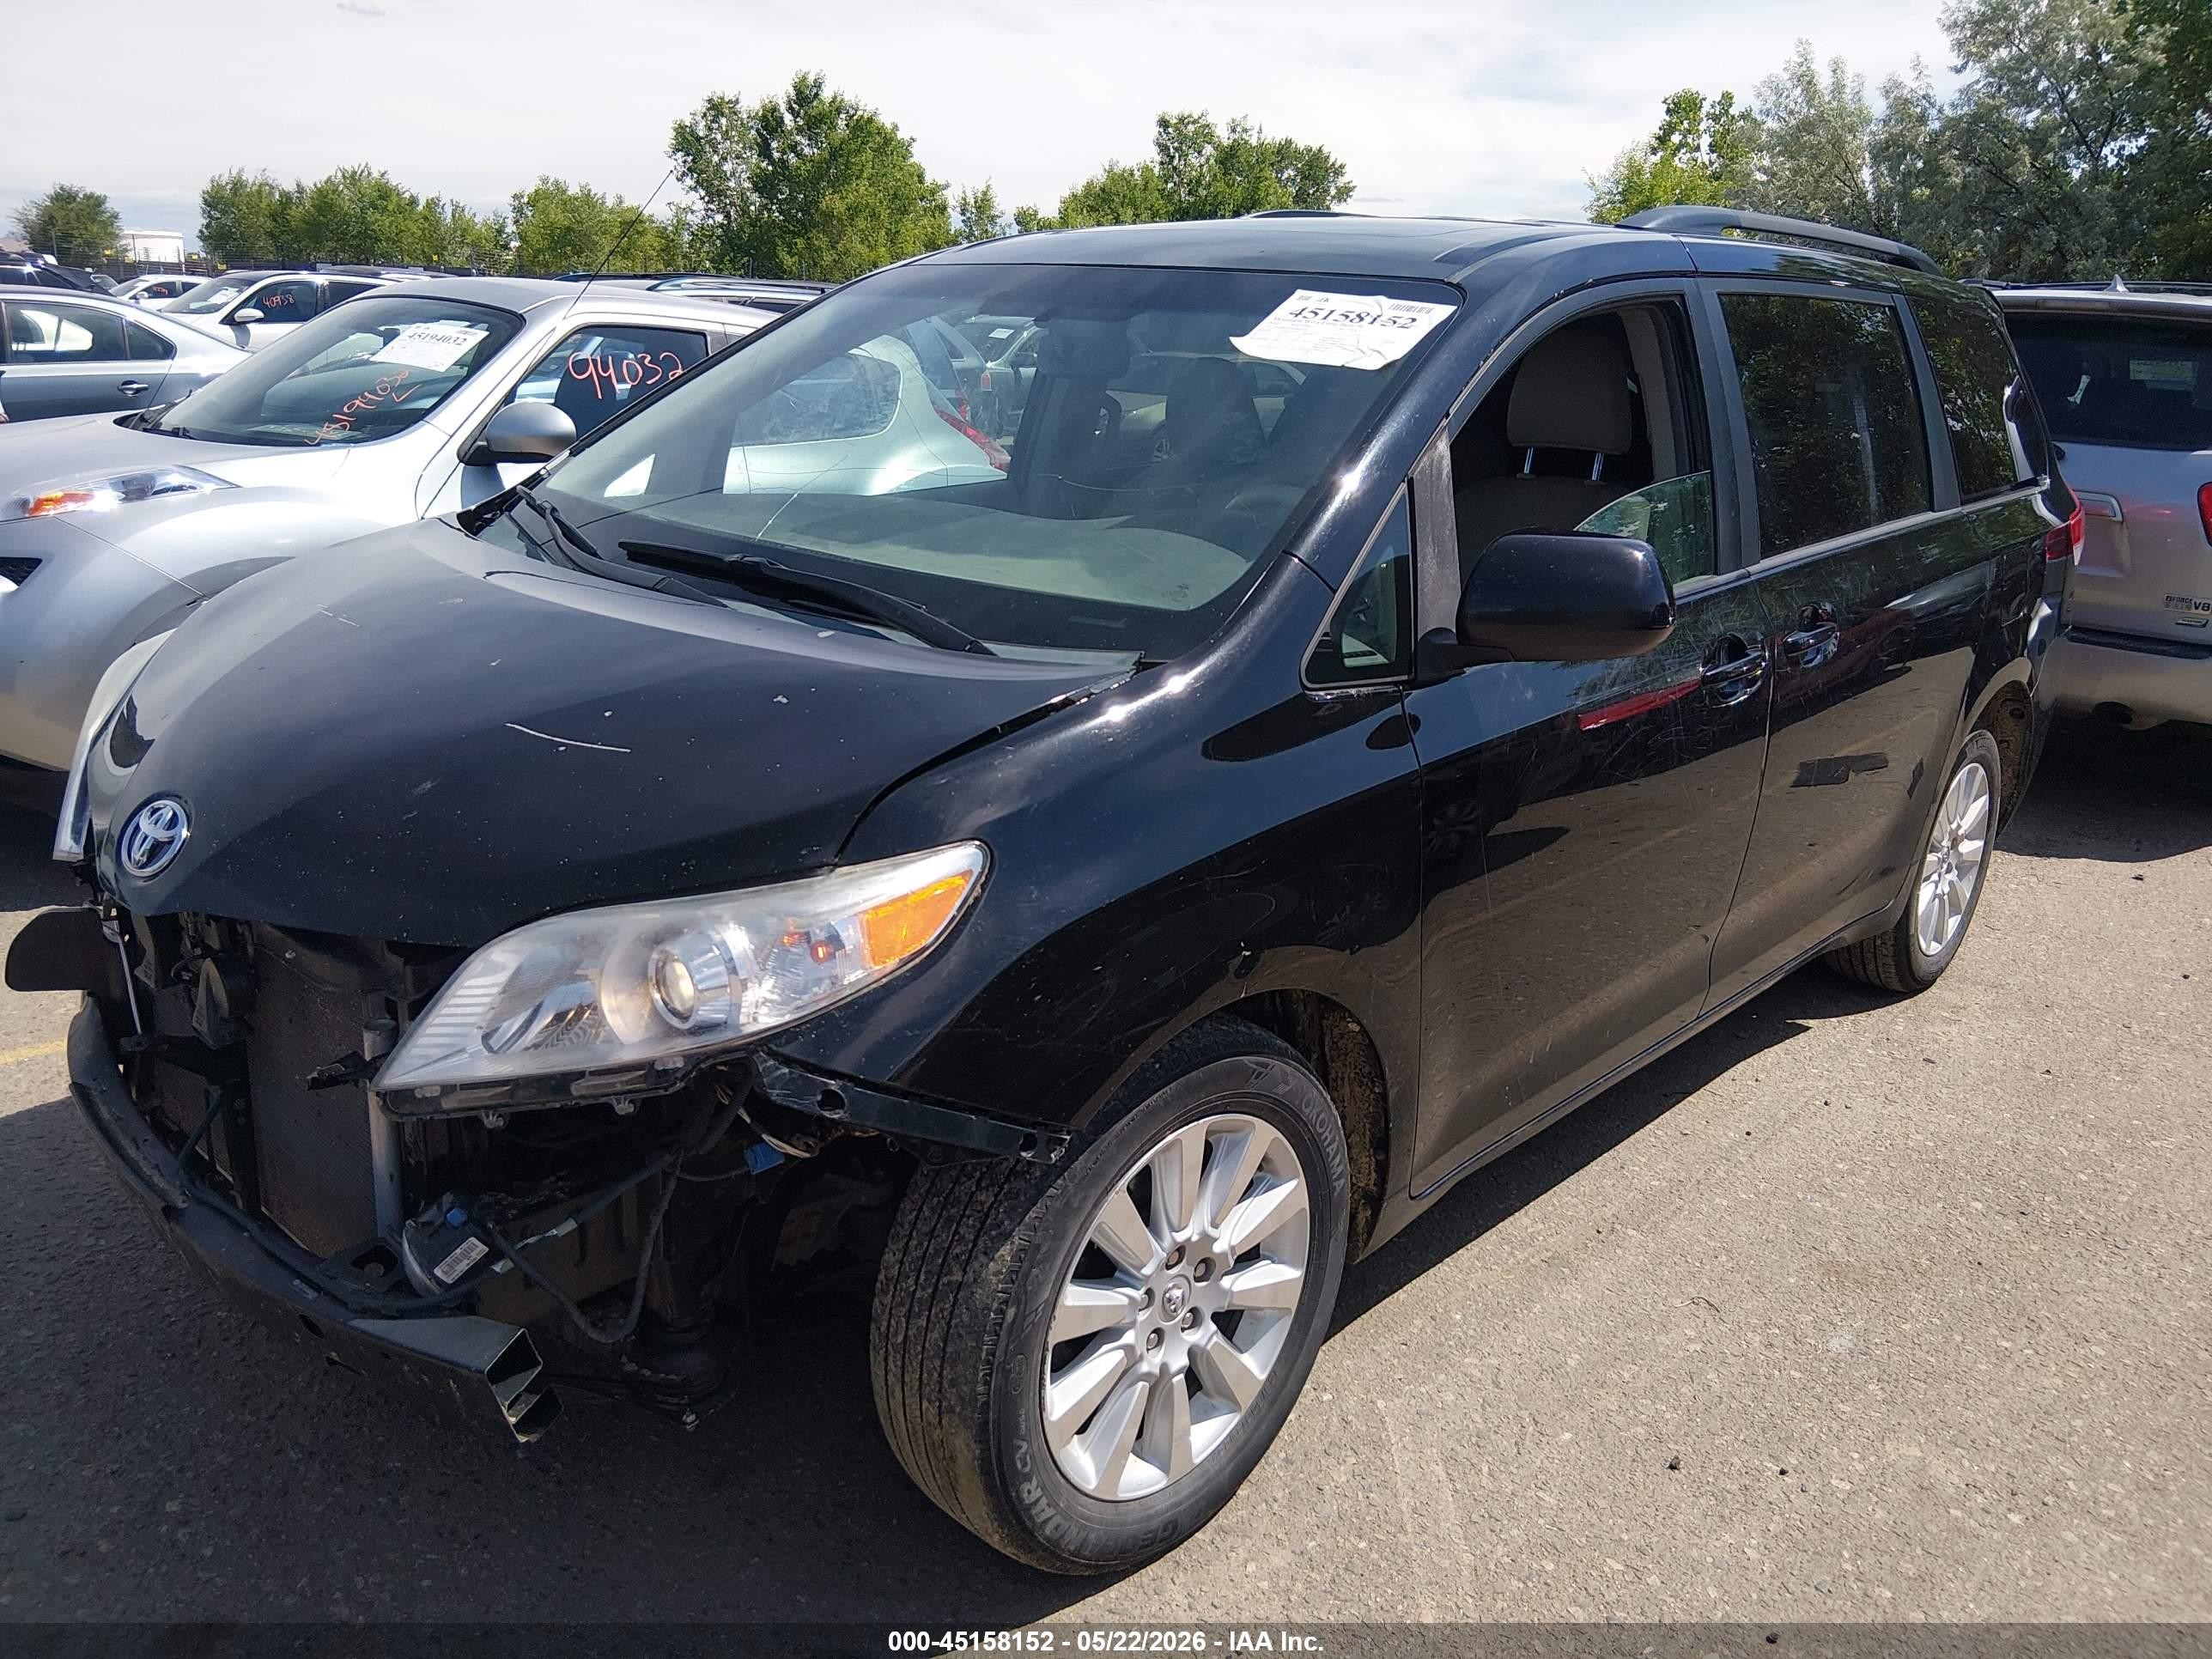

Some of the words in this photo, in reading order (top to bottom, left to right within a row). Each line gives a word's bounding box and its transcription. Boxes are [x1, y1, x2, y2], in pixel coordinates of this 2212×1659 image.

[1288, 306, 1418, 329] 45158152
[568, 351, 684, 399] 94032
[2193, 601, 2210, 612] V8
